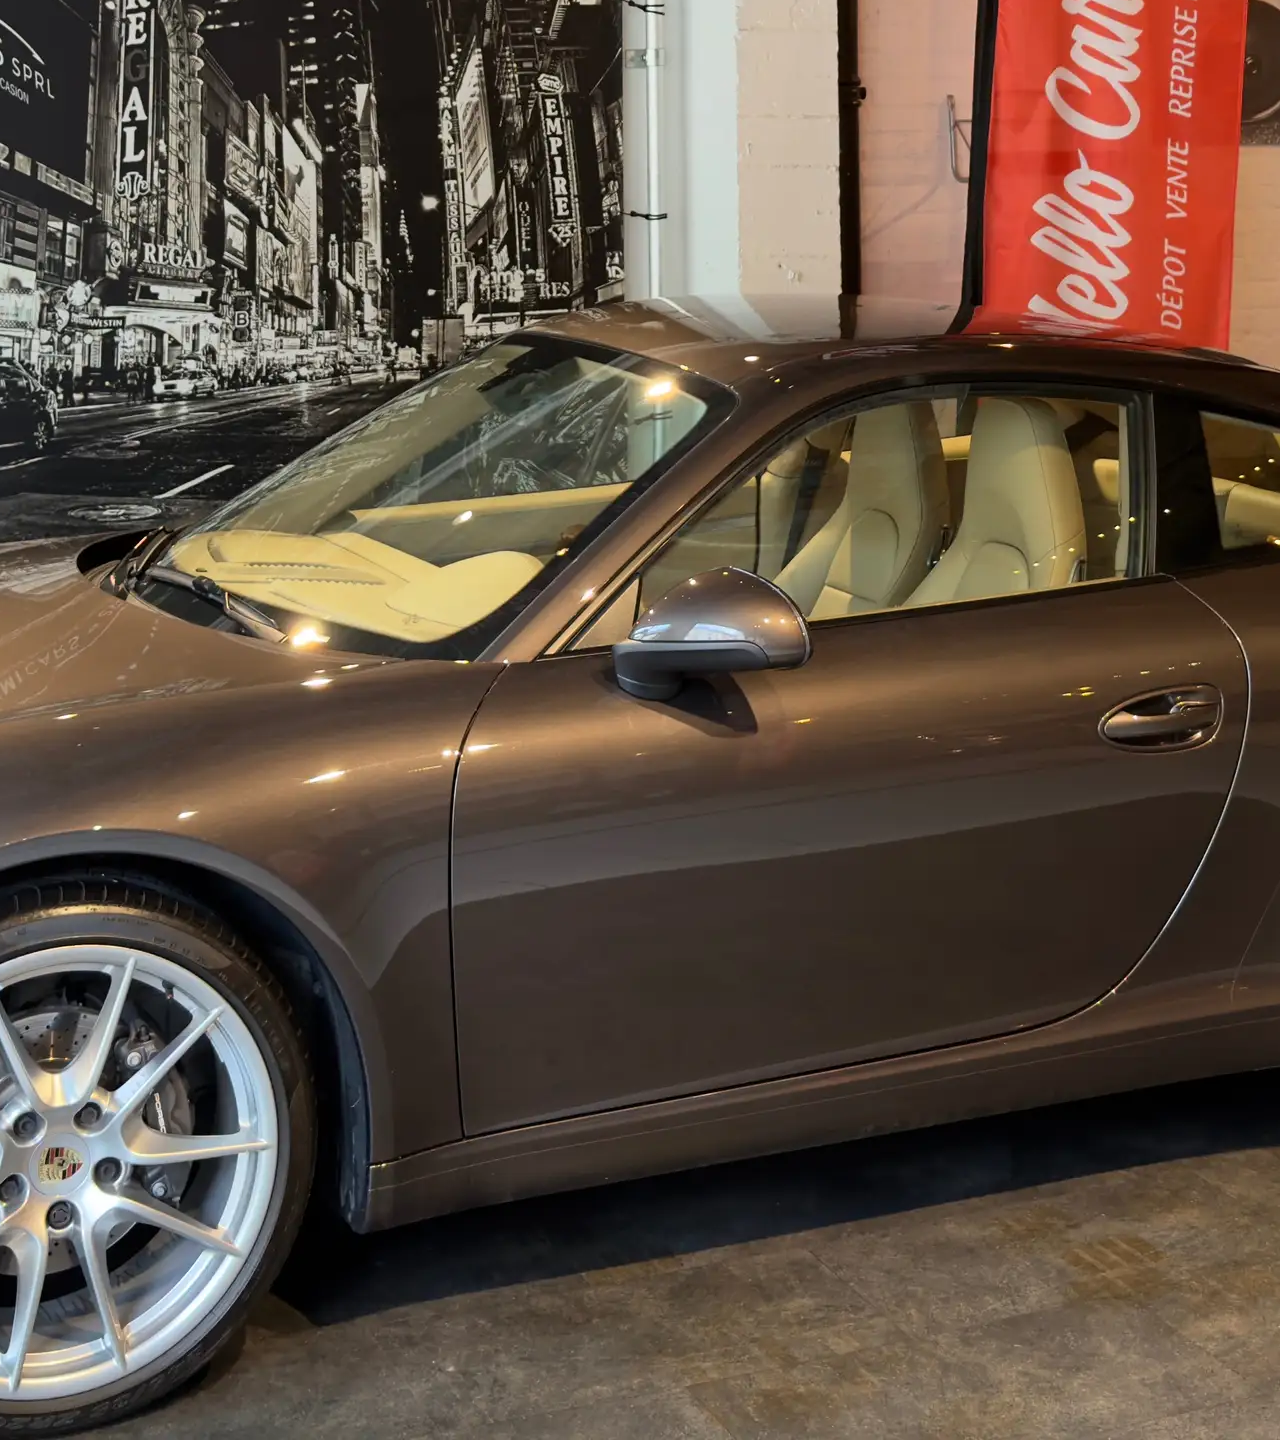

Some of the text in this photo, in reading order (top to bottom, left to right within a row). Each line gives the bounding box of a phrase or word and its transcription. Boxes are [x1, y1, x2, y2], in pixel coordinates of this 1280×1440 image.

[11, 57, 55, 99] SPRL
[1168, 6, 1198, 119] REPRISE
[544, 97, 571, 216] EMPIRE
[1164, 137, 1190, 220] VENTE
[142, 242, 206, 268] REGAL
[1160, 238, 1188, 331] DÉPOT
